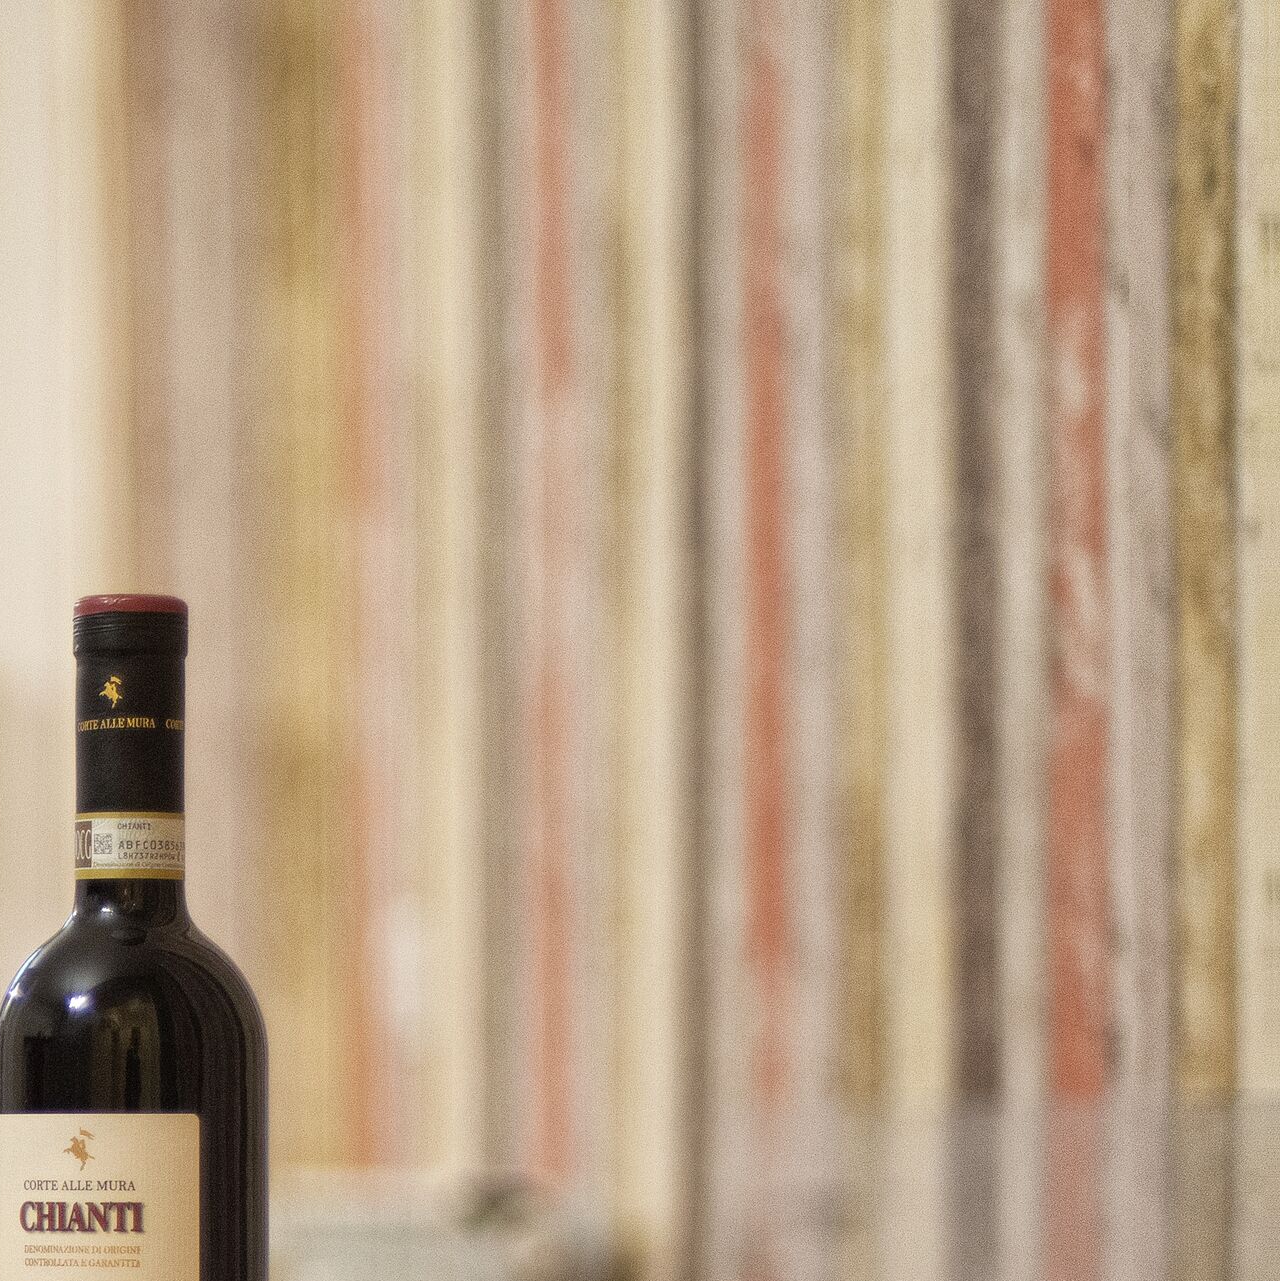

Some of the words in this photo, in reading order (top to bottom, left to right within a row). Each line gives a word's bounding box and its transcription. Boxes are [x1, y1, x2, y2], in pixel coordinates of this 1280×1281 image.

[77, 719, 99, 732] CORTE
[100, 718, 125, 729] ALLE
[126, 717, 156, 729] MURA
[117, 822, 152, 831] CHIANTI
[23, 1179, 59, 1191] CORTE
[61, 1180, 93, 1191] ALLE
[96, 1180, 136, 1192] MURA
[19, 1200, 145, 1233] CHIANTI
[24, 1244, 91, 1254] DENOMINAZIONE
[92, 1245, 102, 1254] DI
[103, 1245, 141, 1255] ORIGINE
[24, 1257, 80, 1267] CONTROLLATA
[88, 1258, 141, 1268] GARANTITA
